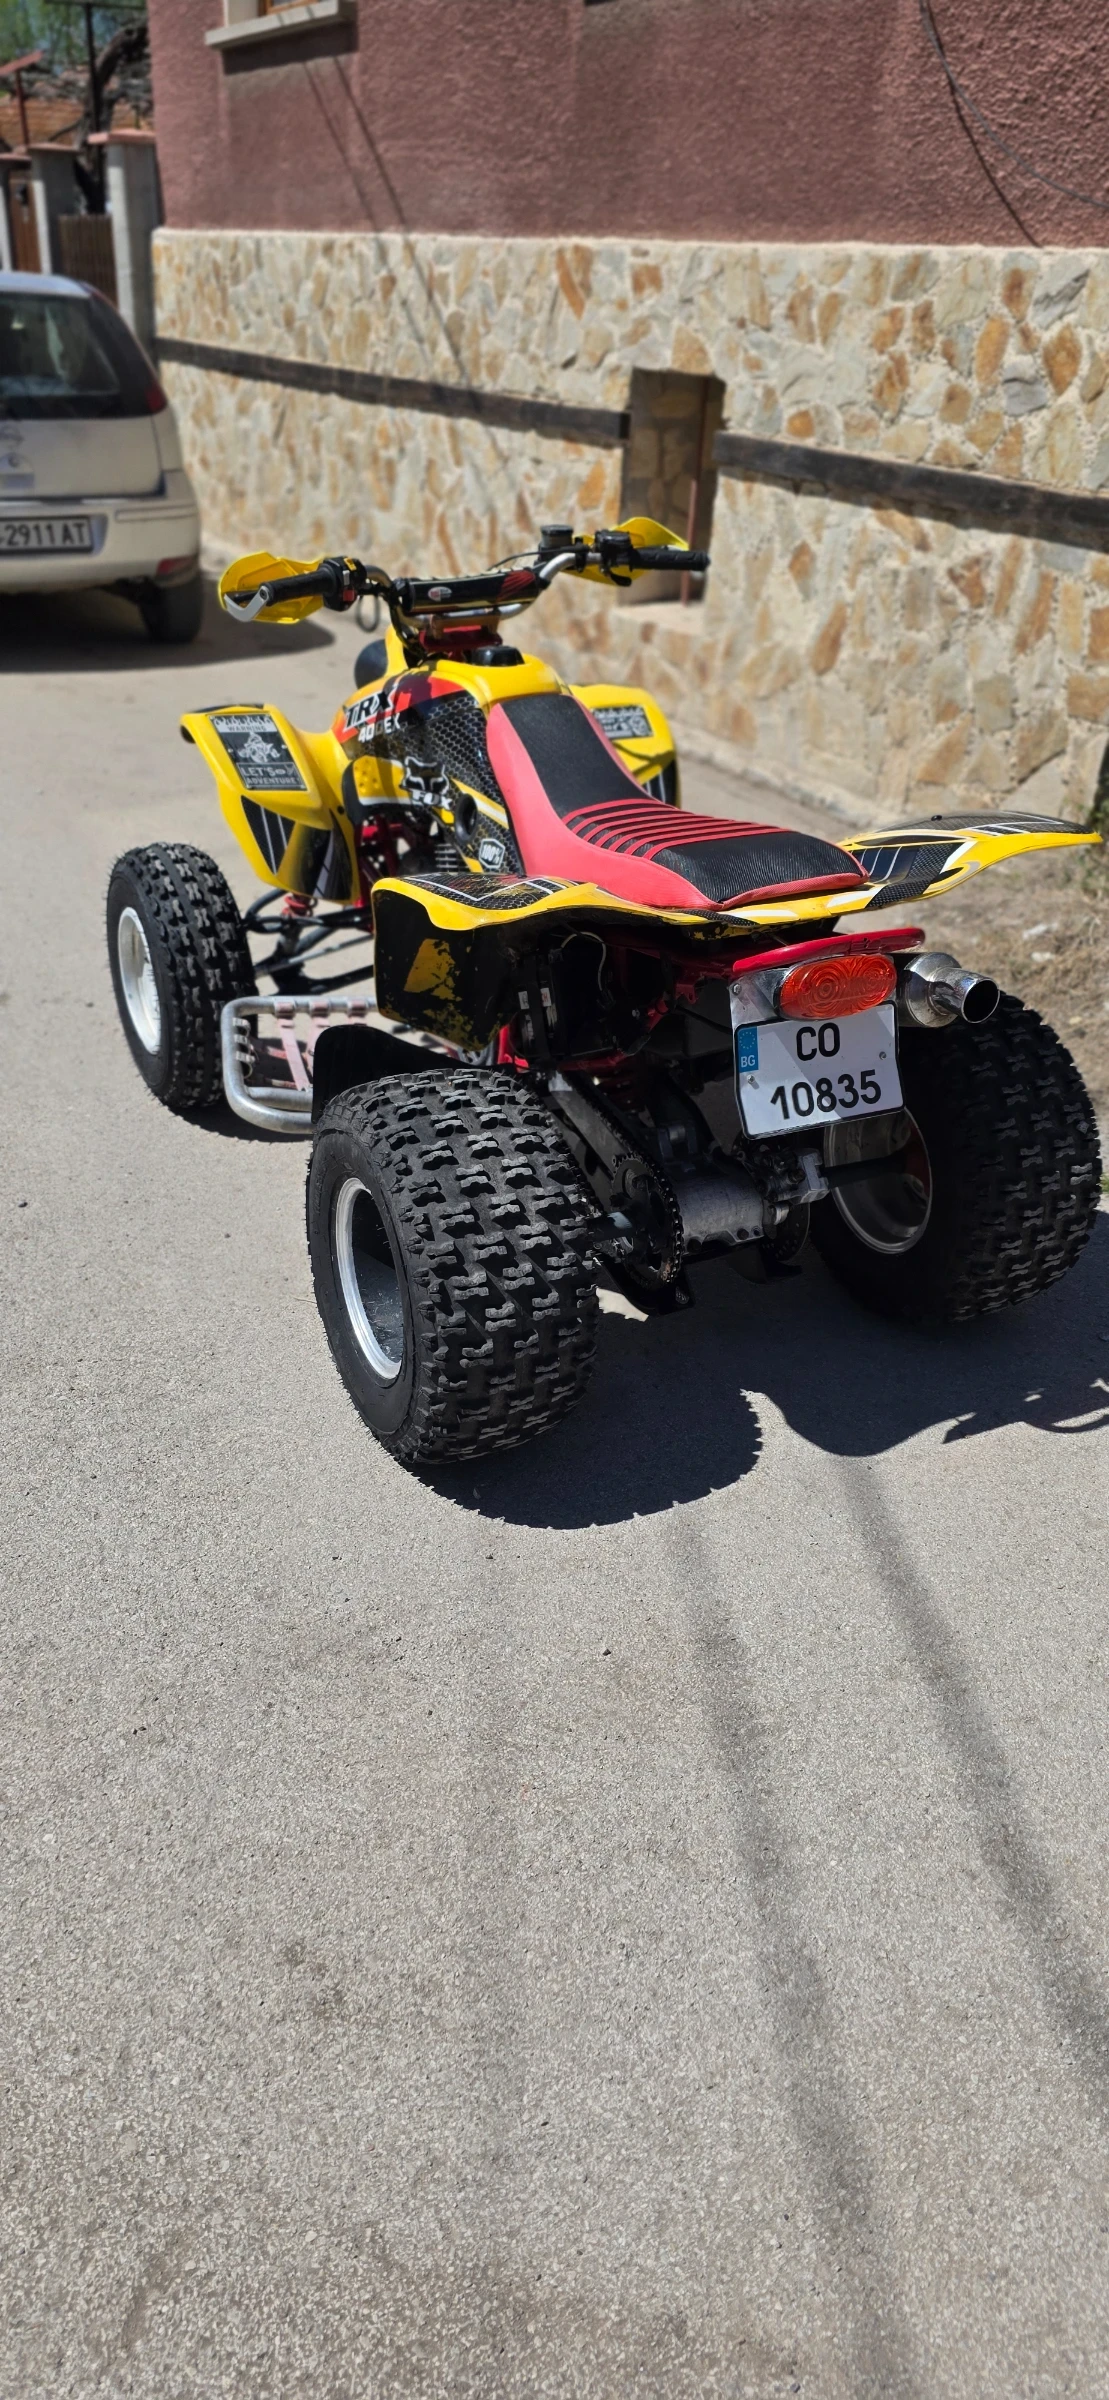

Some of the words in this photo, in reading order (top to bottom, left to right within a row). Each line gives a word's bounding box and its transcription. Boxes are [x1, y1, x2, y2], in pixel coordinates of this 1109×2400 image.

[4, 523, 55, 546] 2911
[62, 523, 86, 545] AT
[343, 684, 397, 732] TRX
[241, 766, 276, 777] LET'S
[246, 777, 297, 785] ADVENTURE
[411, 788, 453, 811] FOX
[796, 1022, 841, 1061] CO
[740, 1055, 756, 1068] BG
[770, 1069, 882, 1120] 10835
